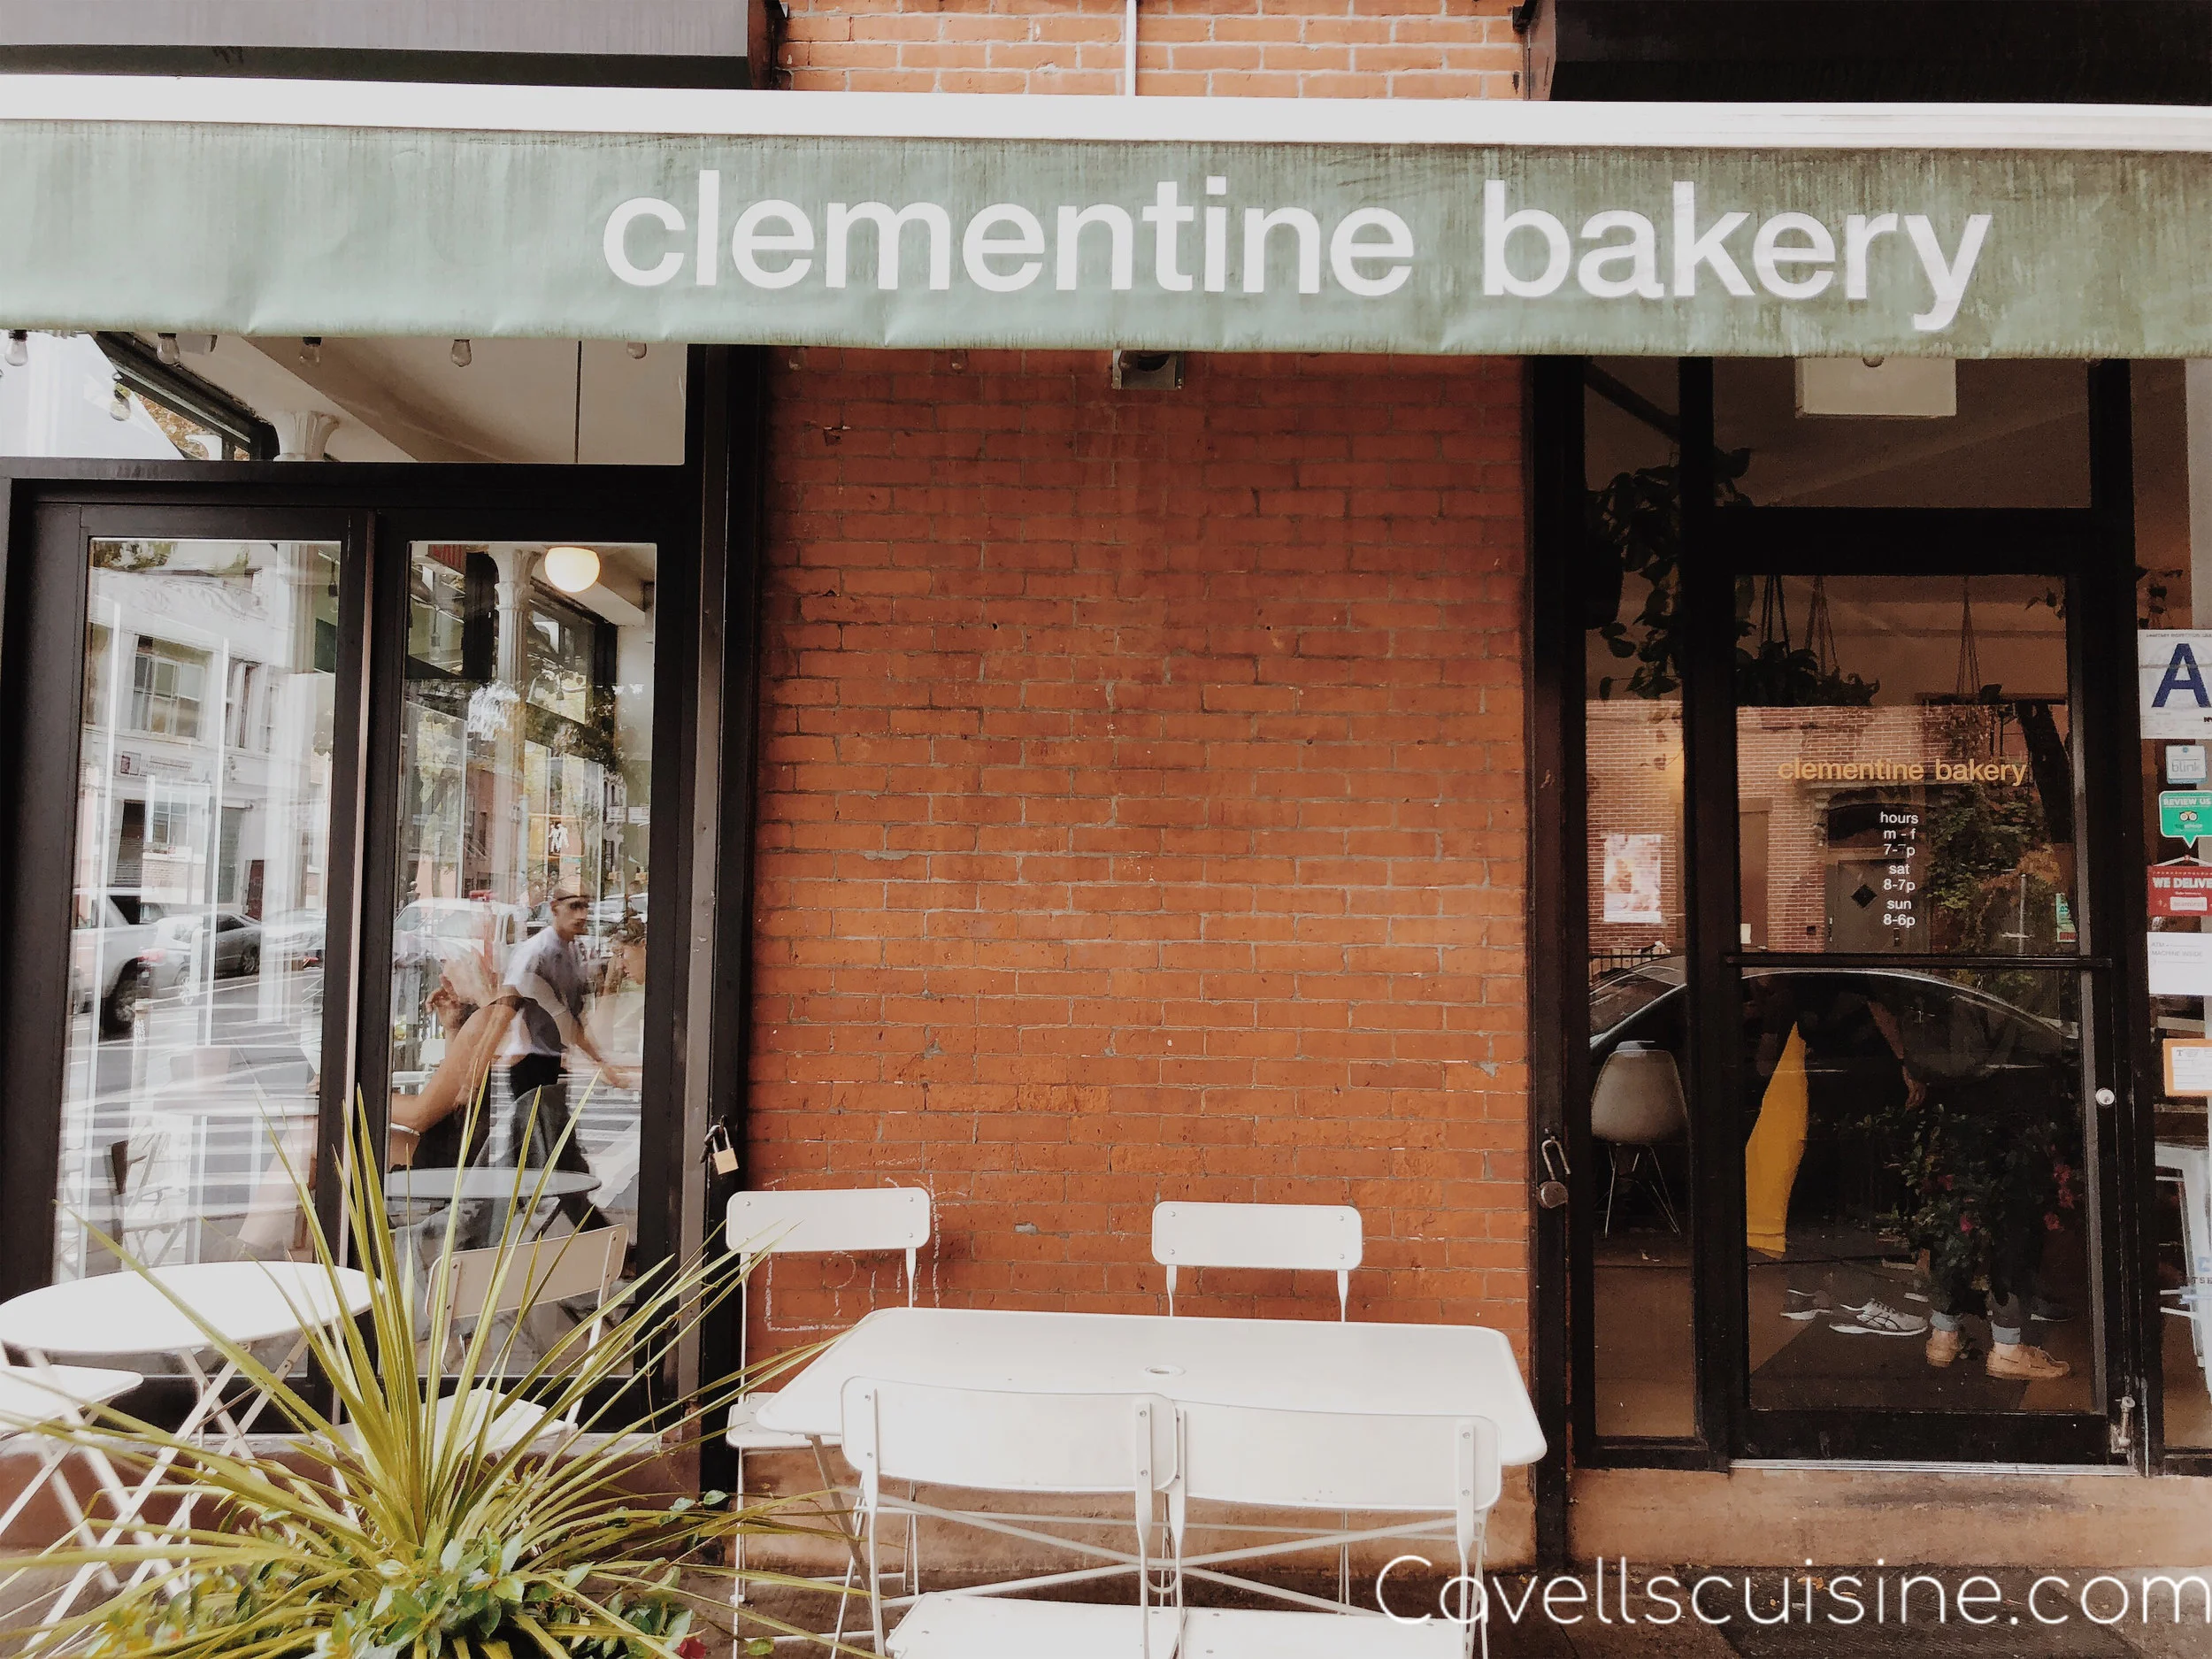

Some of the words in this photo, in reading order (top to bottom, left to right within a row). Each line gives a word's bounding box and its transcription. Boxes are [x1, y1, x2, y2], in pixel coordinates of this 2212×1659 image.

[603, 168, 1415, 297] clementine
[1482, 179, 1993, 332] bakery
[2151, 642, 2212, 708] A
[1778, 757, 1924, 780] clementine
[1935, 757, 2028, 787] bakery
[1880, 811, 1919, 824] hours
[1889, 864, 1910, 875] sat
[1883, 879, 1916, 893] 8-7p
[2152, 877, 2170, 888] WE
[1886, 900, 1912, 910] sun
[1883, 914, 1916, 928] 8-6p
